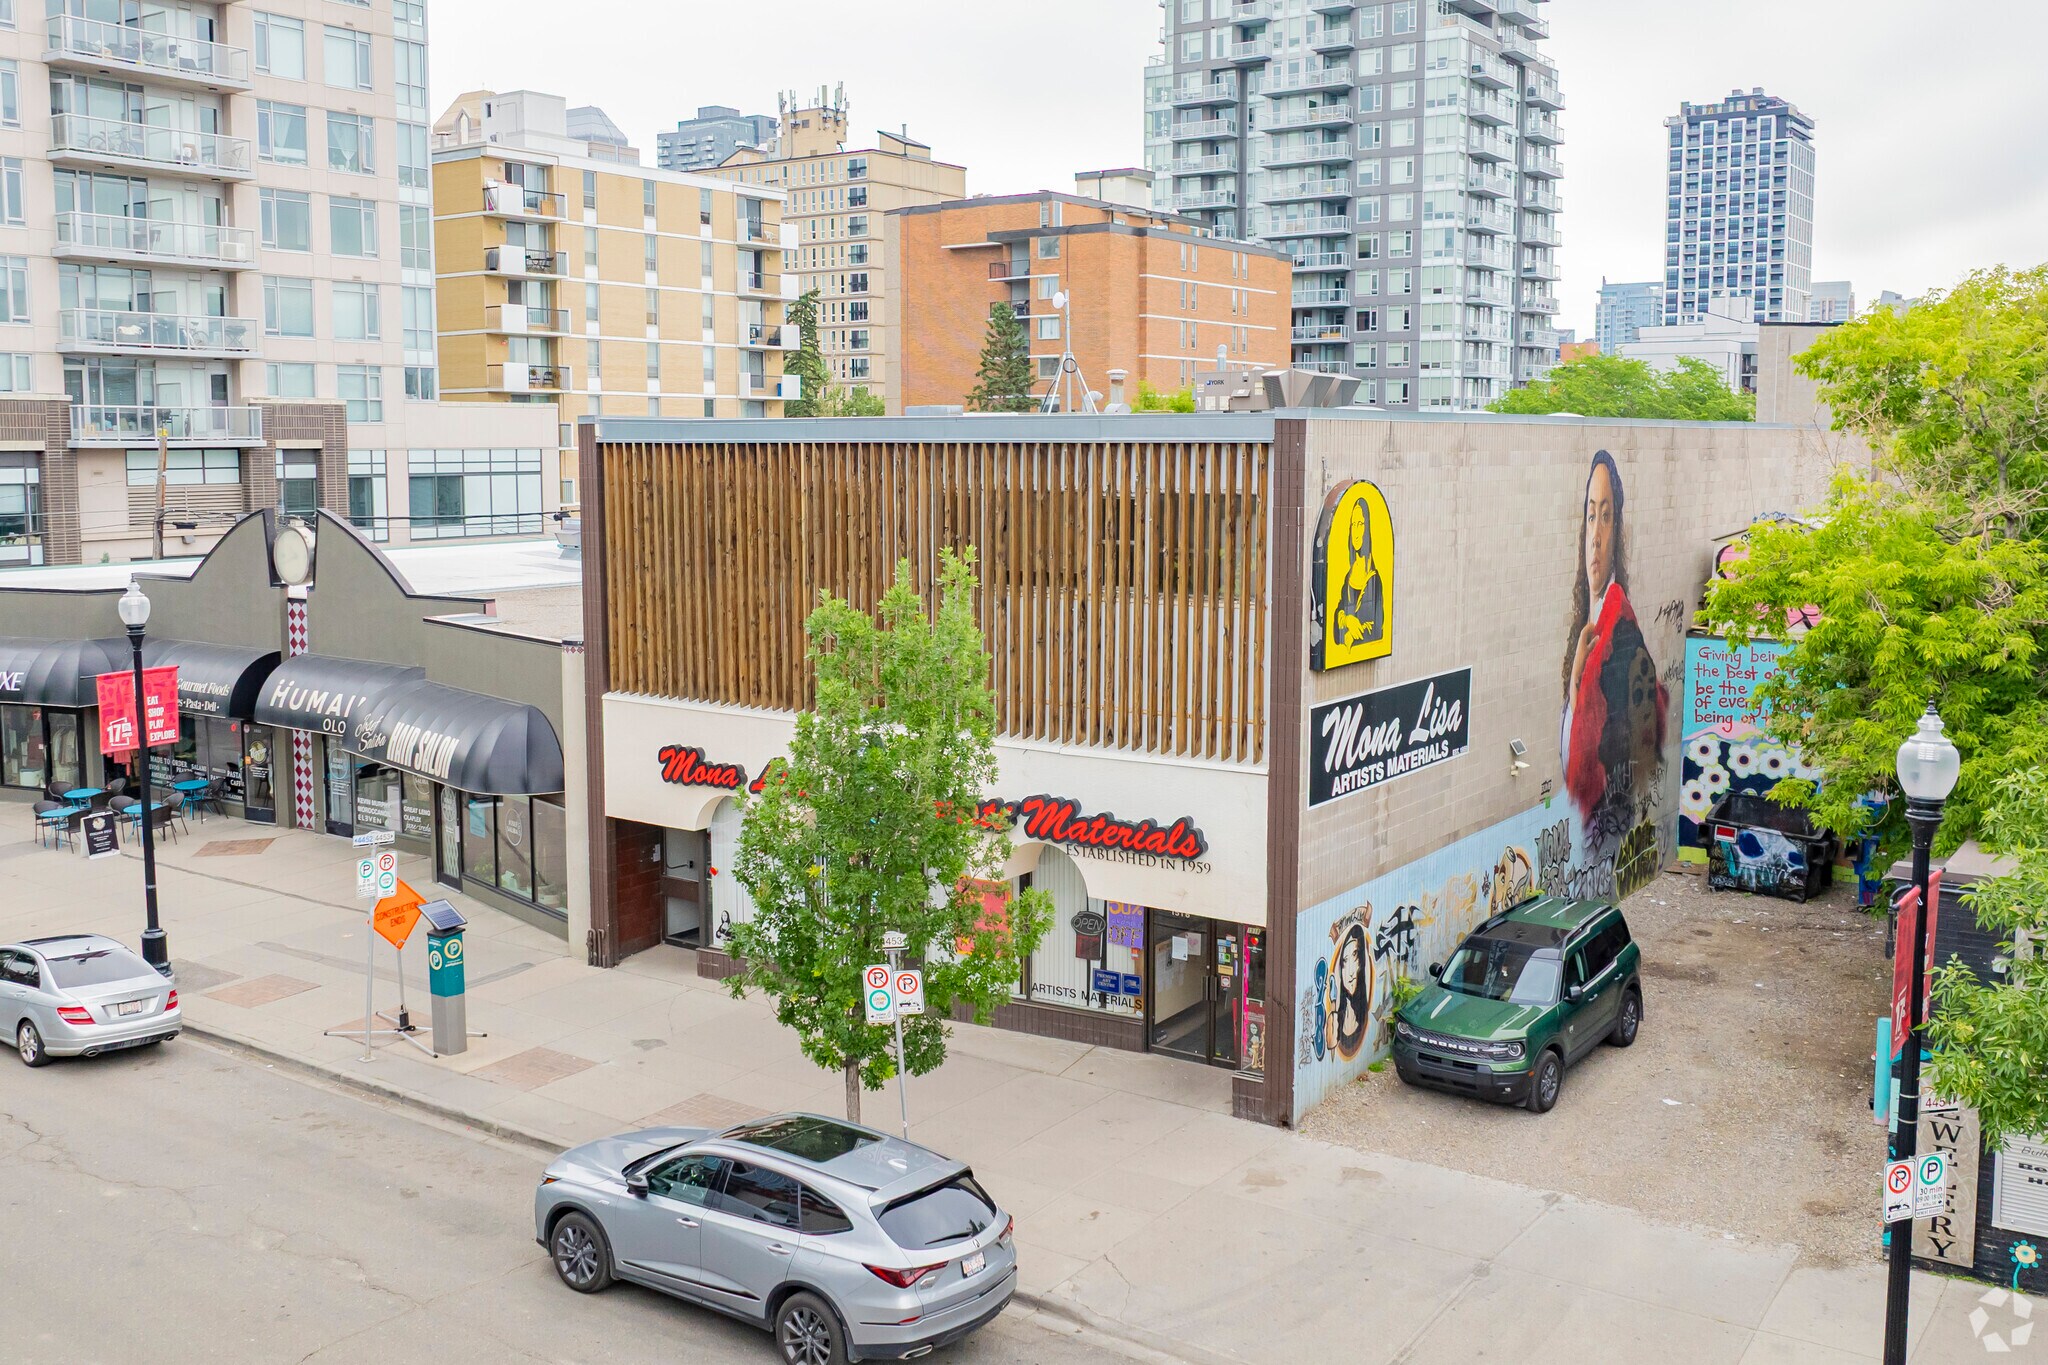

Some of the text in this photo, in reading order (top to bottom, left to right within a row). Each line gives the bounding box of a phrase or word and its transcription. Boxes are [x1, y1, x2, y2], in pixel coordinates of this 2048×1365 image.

[1698, 646, 1742, 670] Giving
[1694, 661, 1720, 679] the
[1726, 663, 1759, 680] best
[206, 681, 231, 698] Foods
[1695, 680, 1748, 697] be the
[146, 695, 159, 706] EAT
[186, 698, 202, 710] Pasta
[1694, 695, 1712, 710] of
[147, 706, 165, 718] SHOP
[1694, 708, 1733, 733] being
[149, 718, 165, 730] PLAY
[1321, 681, 1463, 773] Mona Lisa
[149, 728, 177, 742] EXPLORE
[386, 721, 461, 780] HAIR SALON
[171, 759, 188, 768] ORDER
[658, 744, 743, 790] Mona
[1331, 761, 1385, 797] ARTISTS
[1387, 739, 1449, 778] MATERIALS
[403, 805, 418, 814] GREAT
[1021, 796, 1206, 860] Materials
[1066, 843, 1157, 868] ESTABLISHED
[1181, 860, 1211, 875] 1959
[375, 901, 419, 922] CONSTRUCTION
[390, 915, 406, 928] ENDS
[1073, 918, 1103, 931] OPEN
[1108, 925, 1144, 946] OFF
[1096, 972, 1118, 981] PREMIER
[1031, 982, 1143, 1011] ARTISTS MATERIALS
[1419, 1036, 1479, 1053] BRONCO
[1919, 1186, 1943, 1197] 30 min
